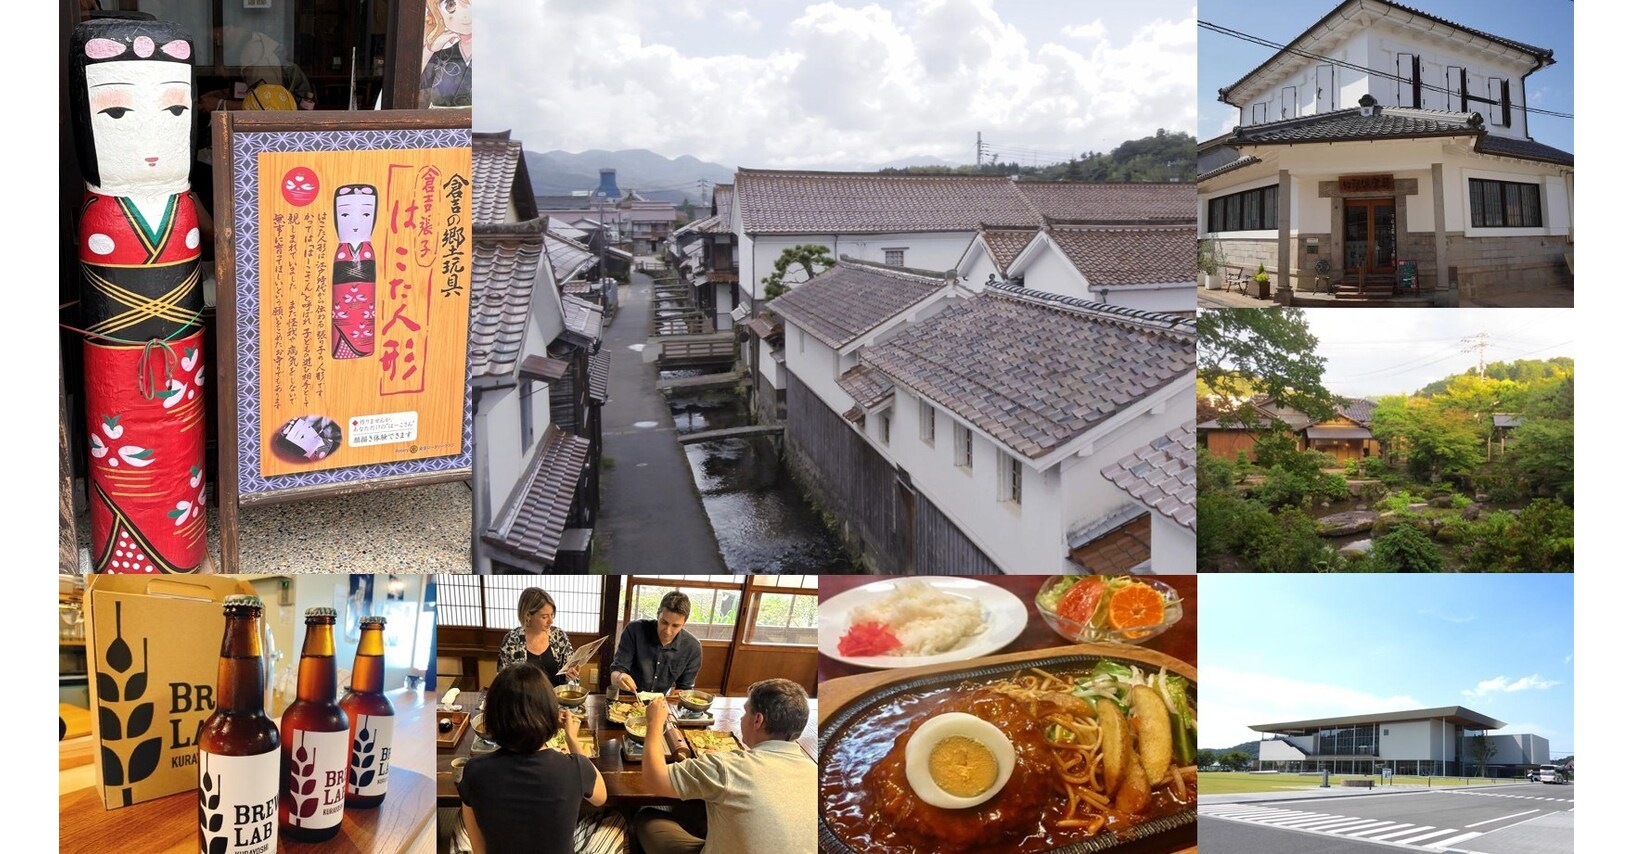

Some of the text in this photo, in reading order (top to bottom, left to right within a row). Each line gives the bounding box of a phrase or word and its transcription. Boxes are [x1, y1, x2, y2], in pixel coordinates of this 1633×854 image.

[418, 168, 439, 258] 倉吉張子
[441, 173, 469, 297] 倉吉の郷土玩具
[168, 682, 216, 714] BR
[233, 821, 273, 847] LAB
